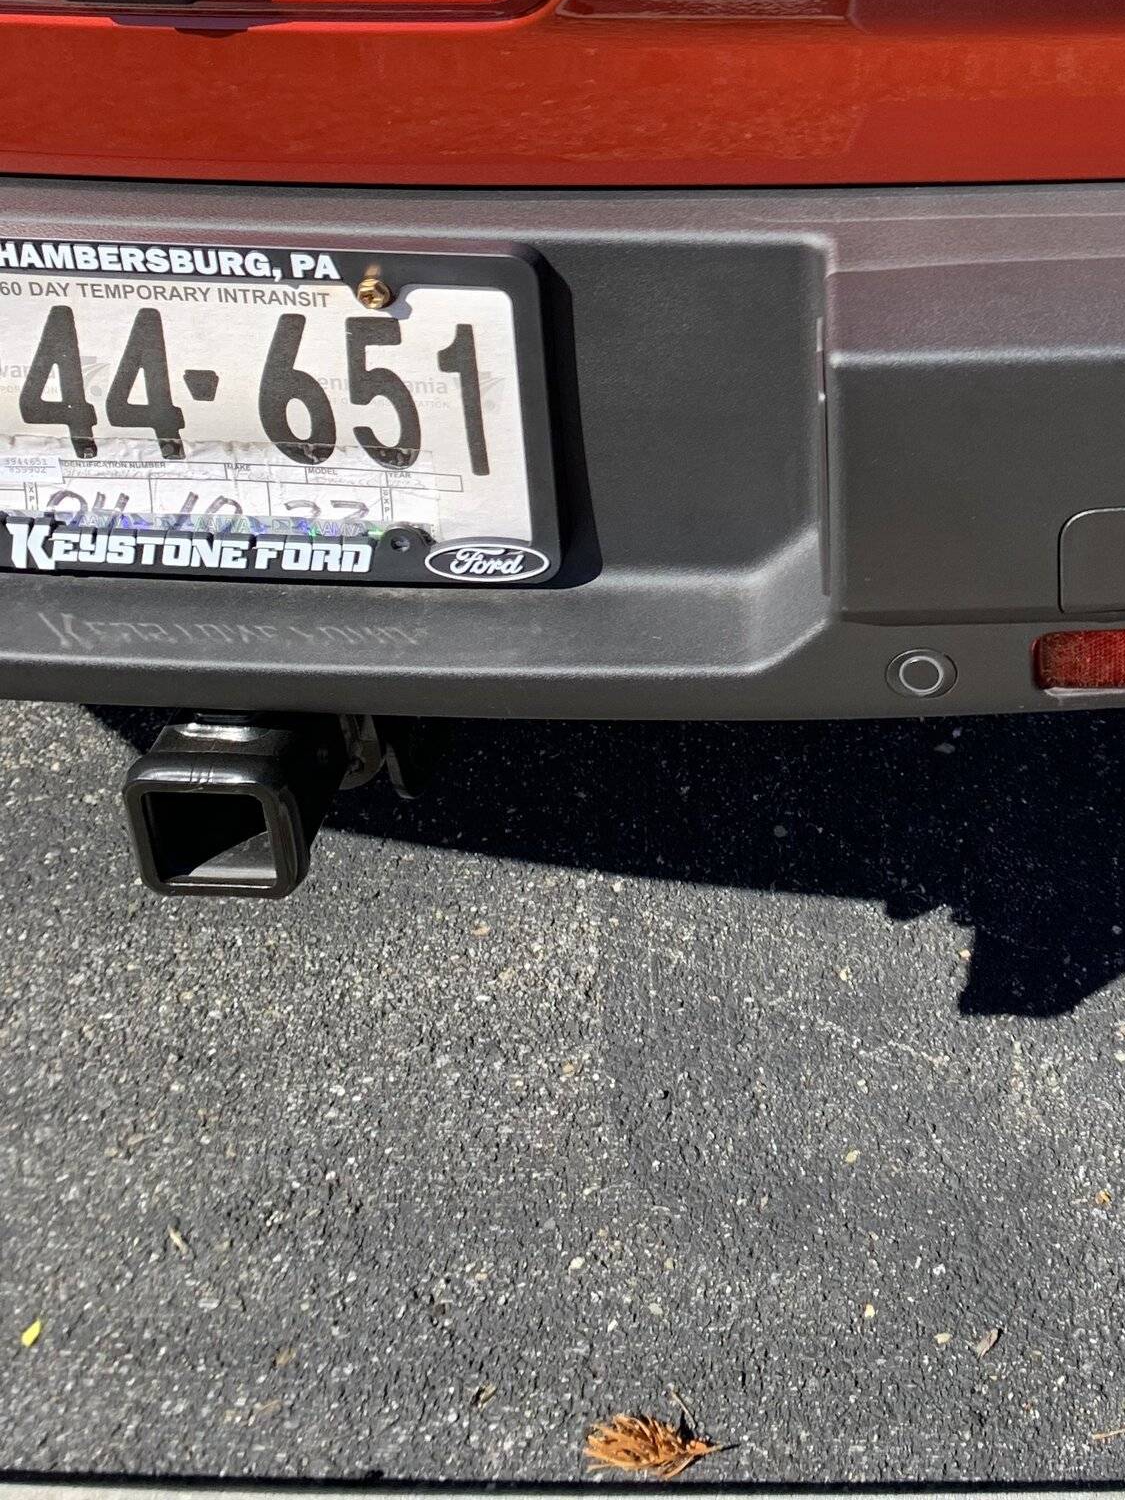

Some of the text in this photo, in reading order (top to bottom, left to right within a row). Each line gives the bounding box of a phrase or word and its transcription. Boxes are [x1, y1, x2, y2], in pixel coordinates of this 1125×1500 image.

[290, 252, 341, 280] PA
[0, 281, 330, 308] 60 DAY TEMPORARY INTRANSIT
[226, 463, 251, 471] MAKE
[308, 467, 338, 476] MODEL
[6, 522, 373, 573] KEYSTONE FORD
[450, 547, 524, 576] Ford
